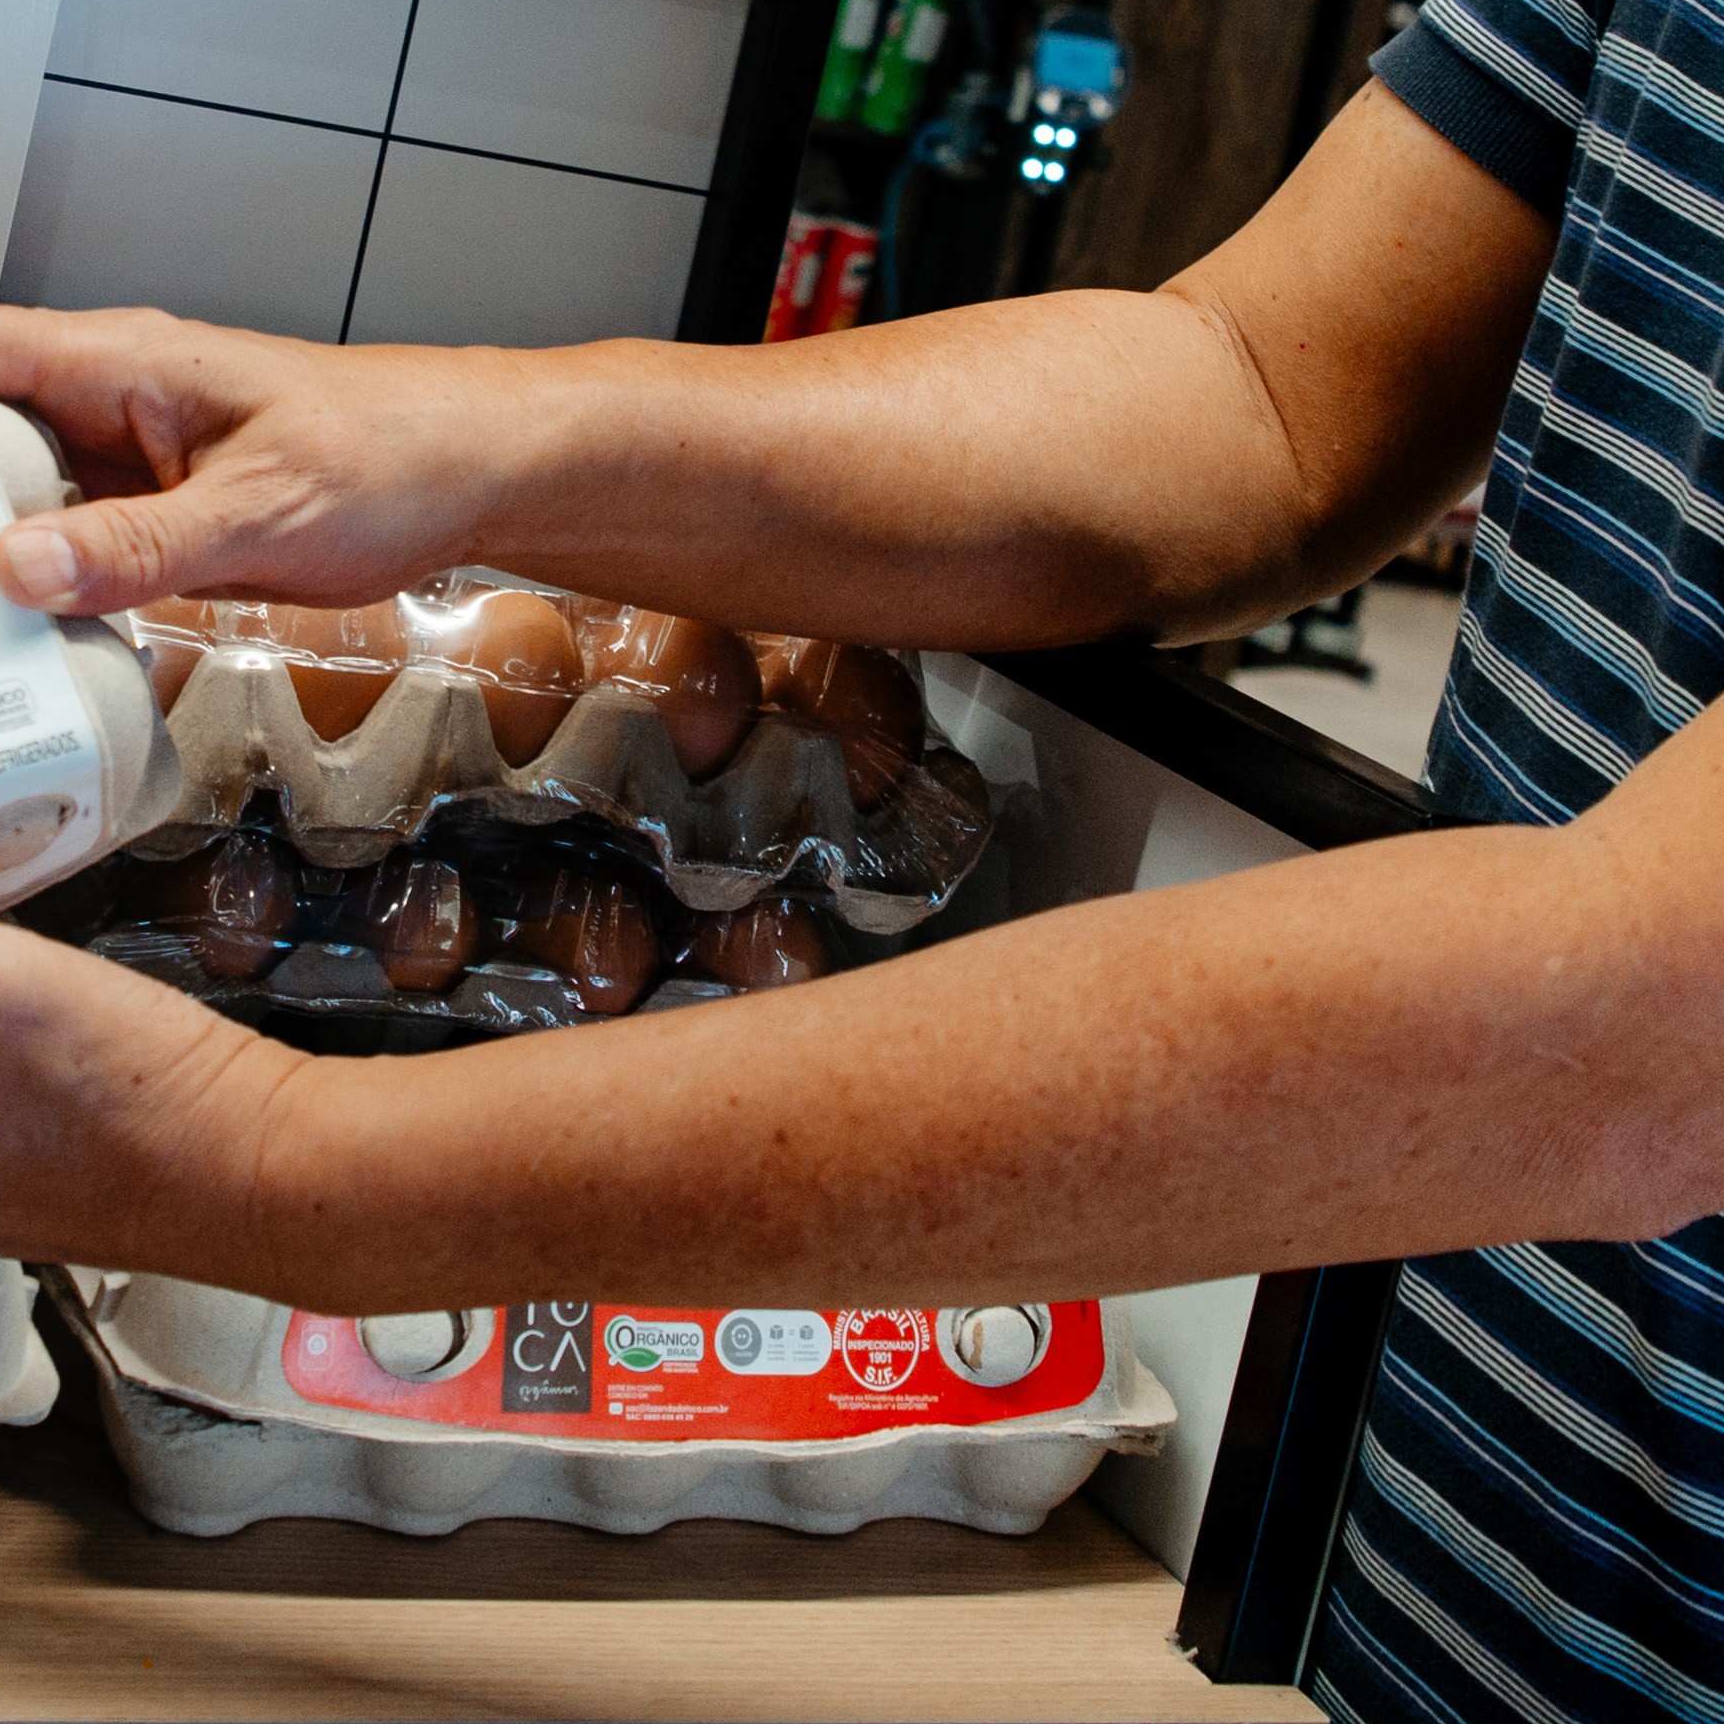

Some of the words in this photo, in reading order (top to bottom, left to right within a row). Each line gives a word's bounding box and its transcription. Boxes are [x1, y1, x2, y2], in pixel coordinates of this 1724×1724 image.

[850, 1308, 911, 1337] BRASIL
[616, 1325, 700, 1349] ORGÂNICO
[847, 1339, 914, 1351] INSPECIONADO
[513, 1329, 587, 1373] CA
[666, 1348, 699, 1357] BRASIL
[868, 1351, 893, 1363] 1901
[864, 1367, 897, 1386] S.I.F.
